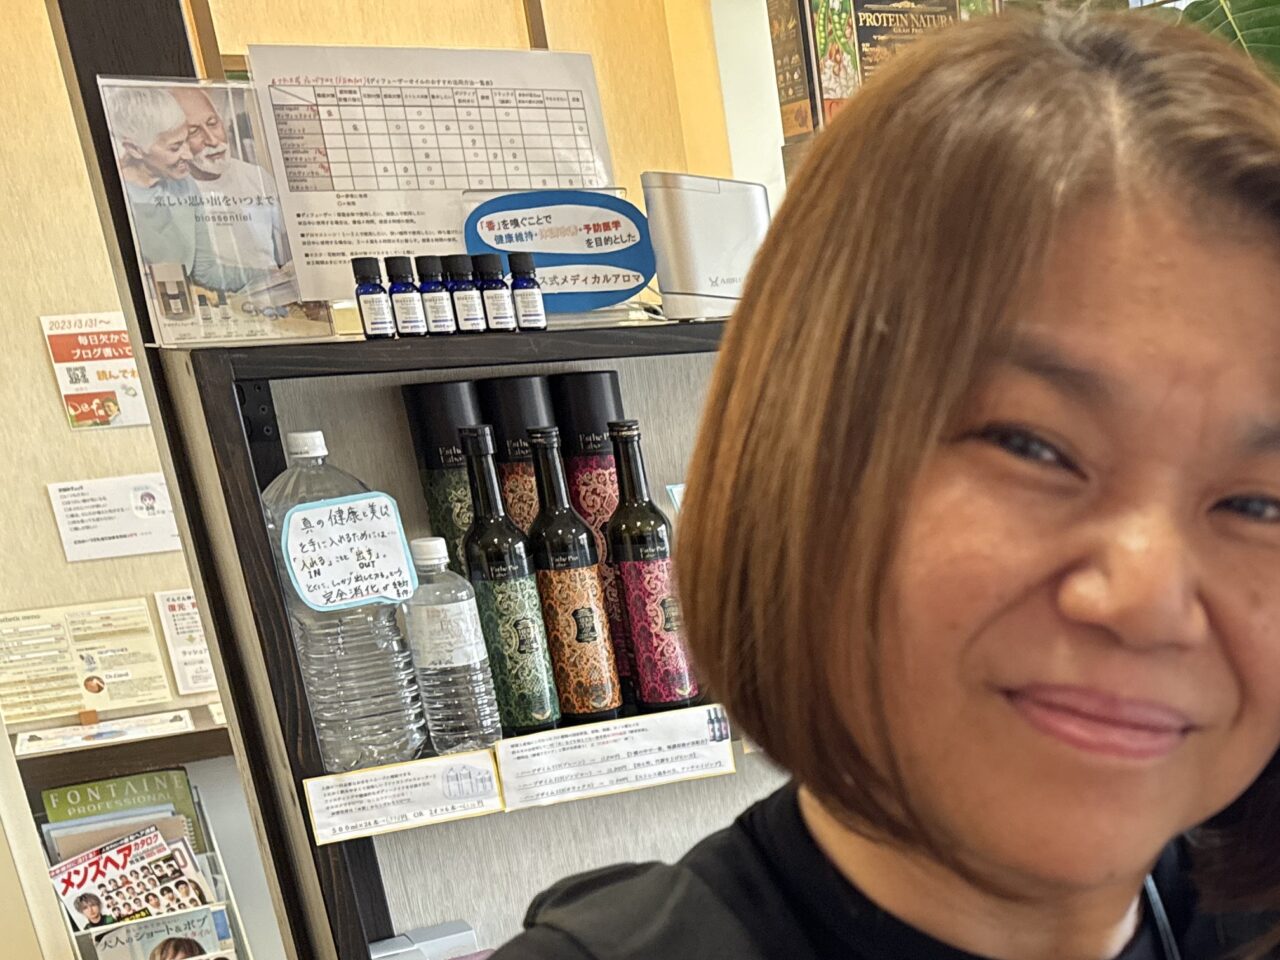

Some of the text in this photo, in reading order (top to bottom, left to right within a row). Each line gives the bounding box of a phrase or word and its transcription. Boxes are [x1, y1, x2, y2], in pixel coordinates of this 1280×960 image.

[858, 12, 907, 28] PROTEIN
[585, 232, 637, 249] を目的とした
[539, 273, 642, 287] ス式メディカルアロマ
[358, 561, 377, 570] OUT
[308, 569, 321, 579] IN
[50, 773, 184, 808] FONTAINE
[67, 792, 171, 816] PROFESSIONAL
[133, 834, 160, 851] カタログ
